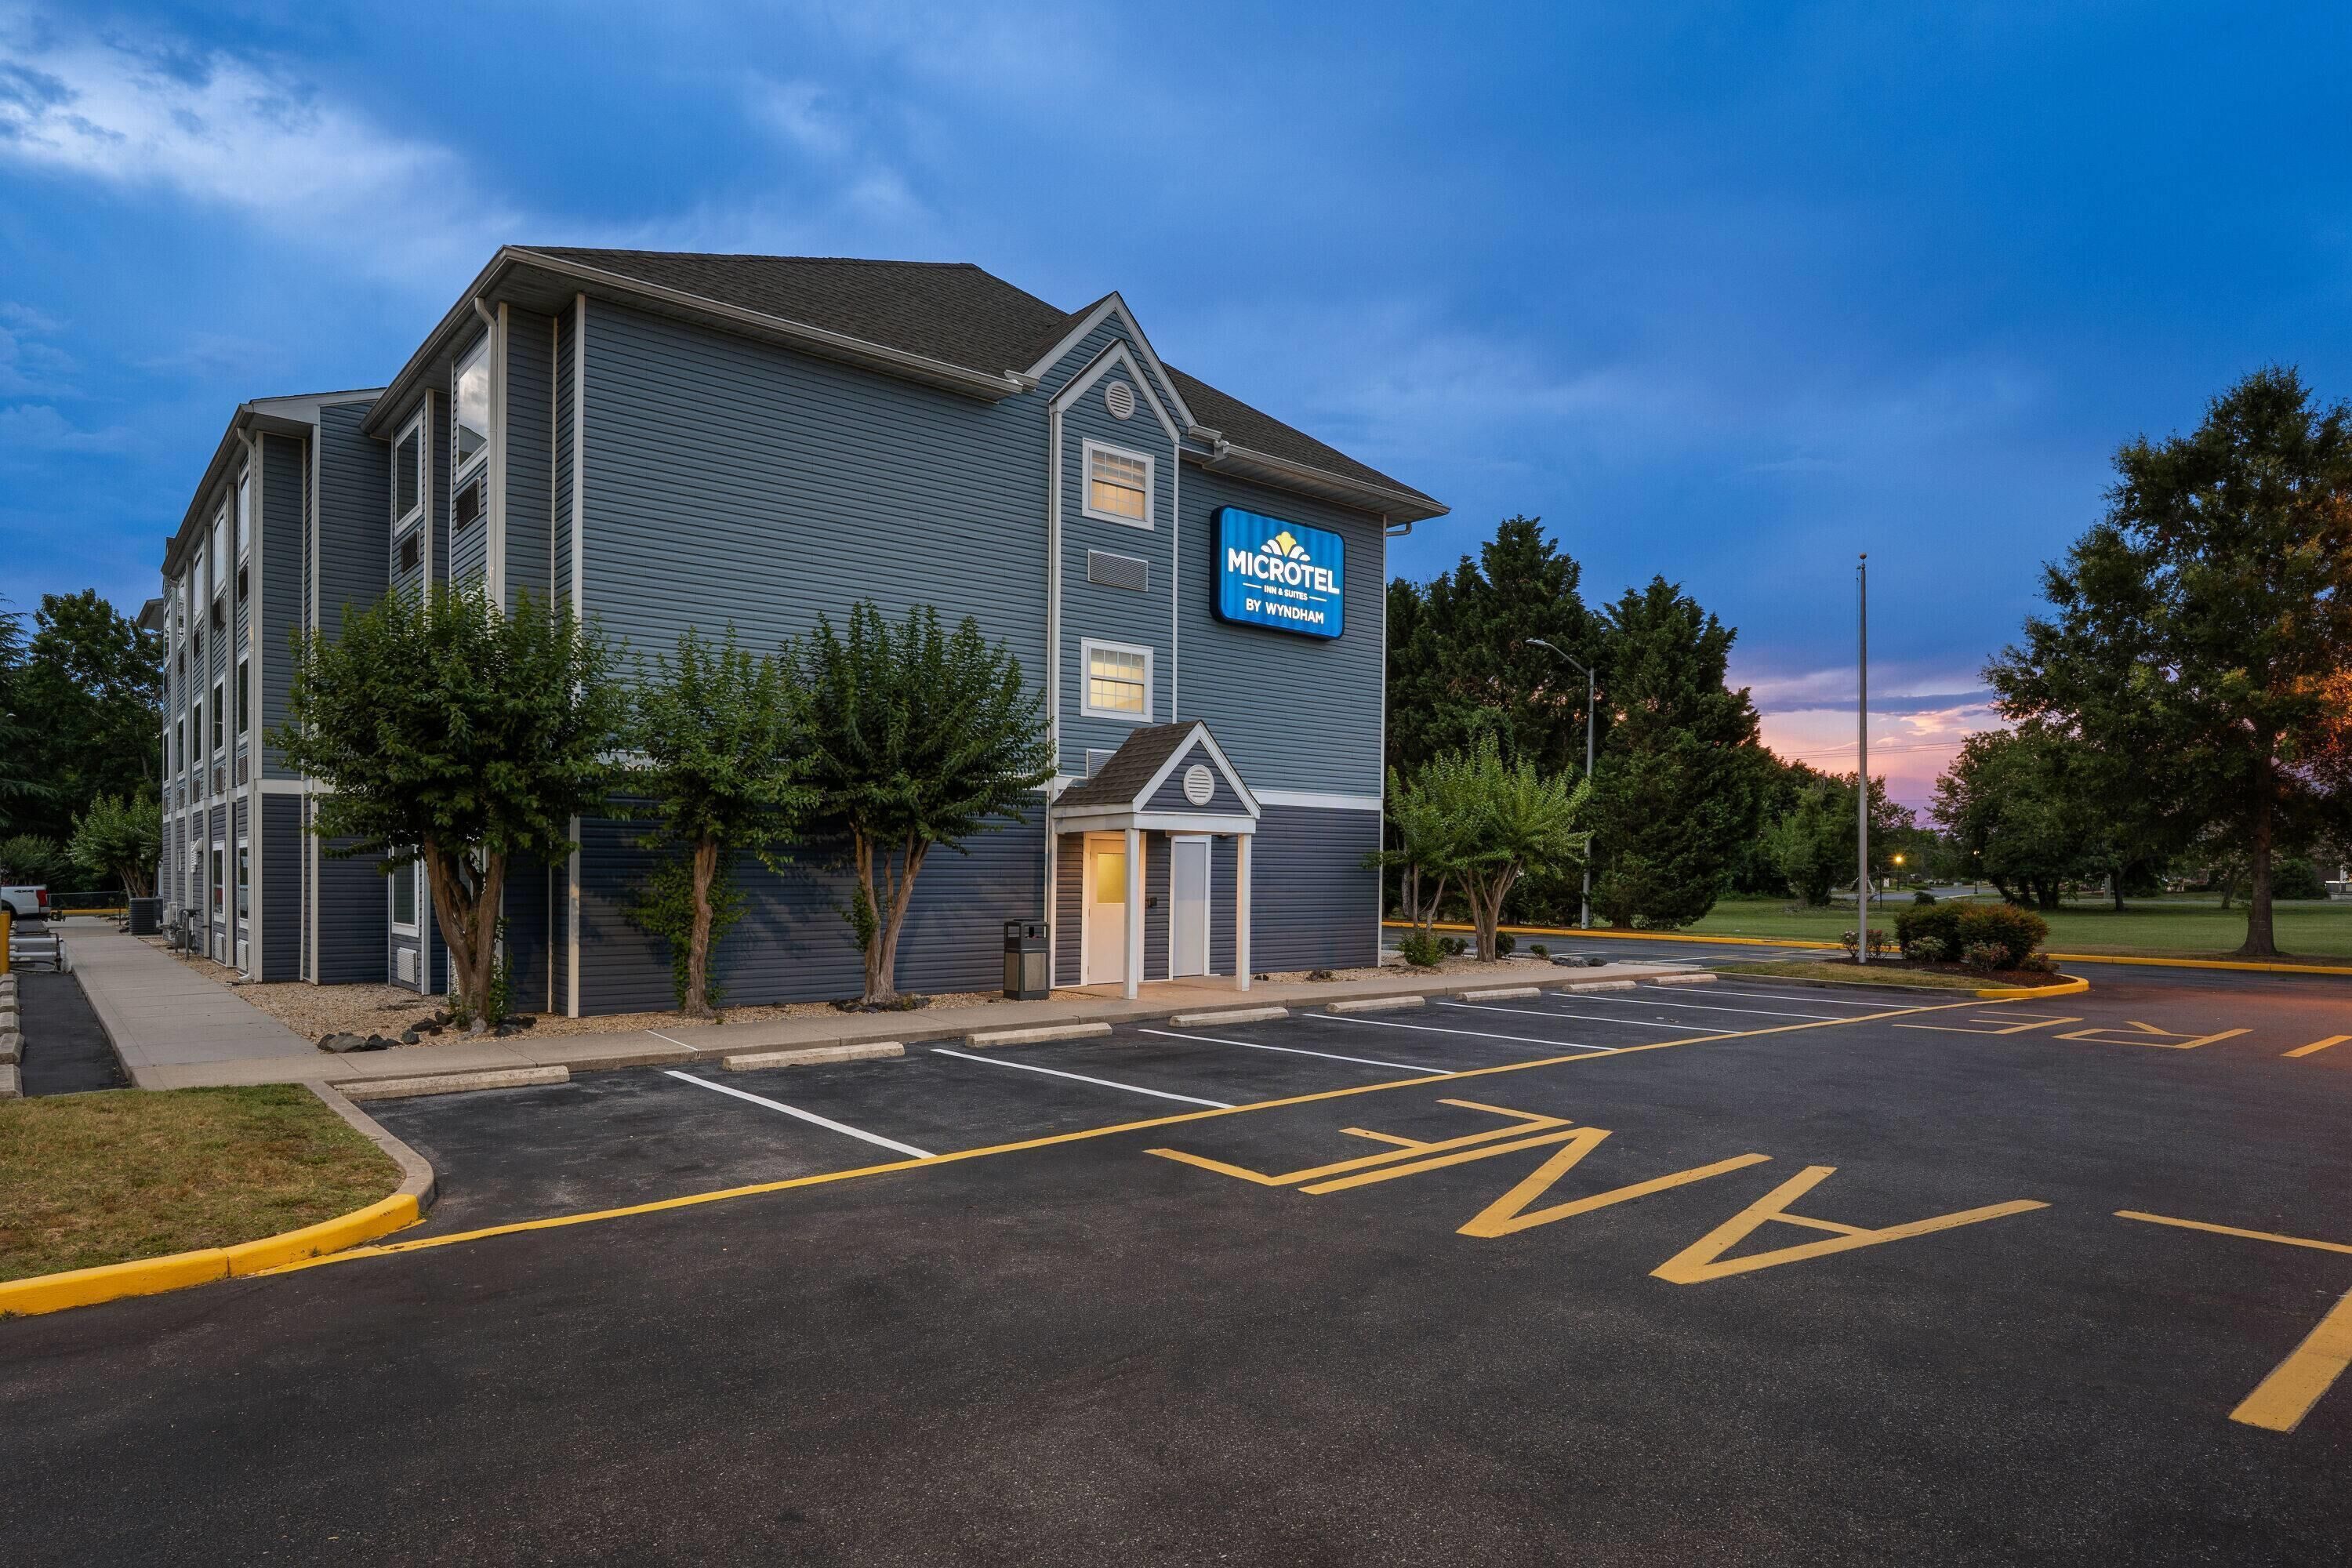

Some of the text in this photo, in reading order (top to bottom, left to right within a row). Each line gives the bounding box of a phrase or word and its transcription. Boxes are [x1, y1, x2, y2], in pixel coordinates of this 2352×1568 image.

[1228, 547, 1340, 594] MICROTEL
[1246, 597, 1324, 625] BY WYNDHAM
[1264, 584, 1308, 601] INN & SUITES
[1142, 1099, 2352, 1434] LANE
